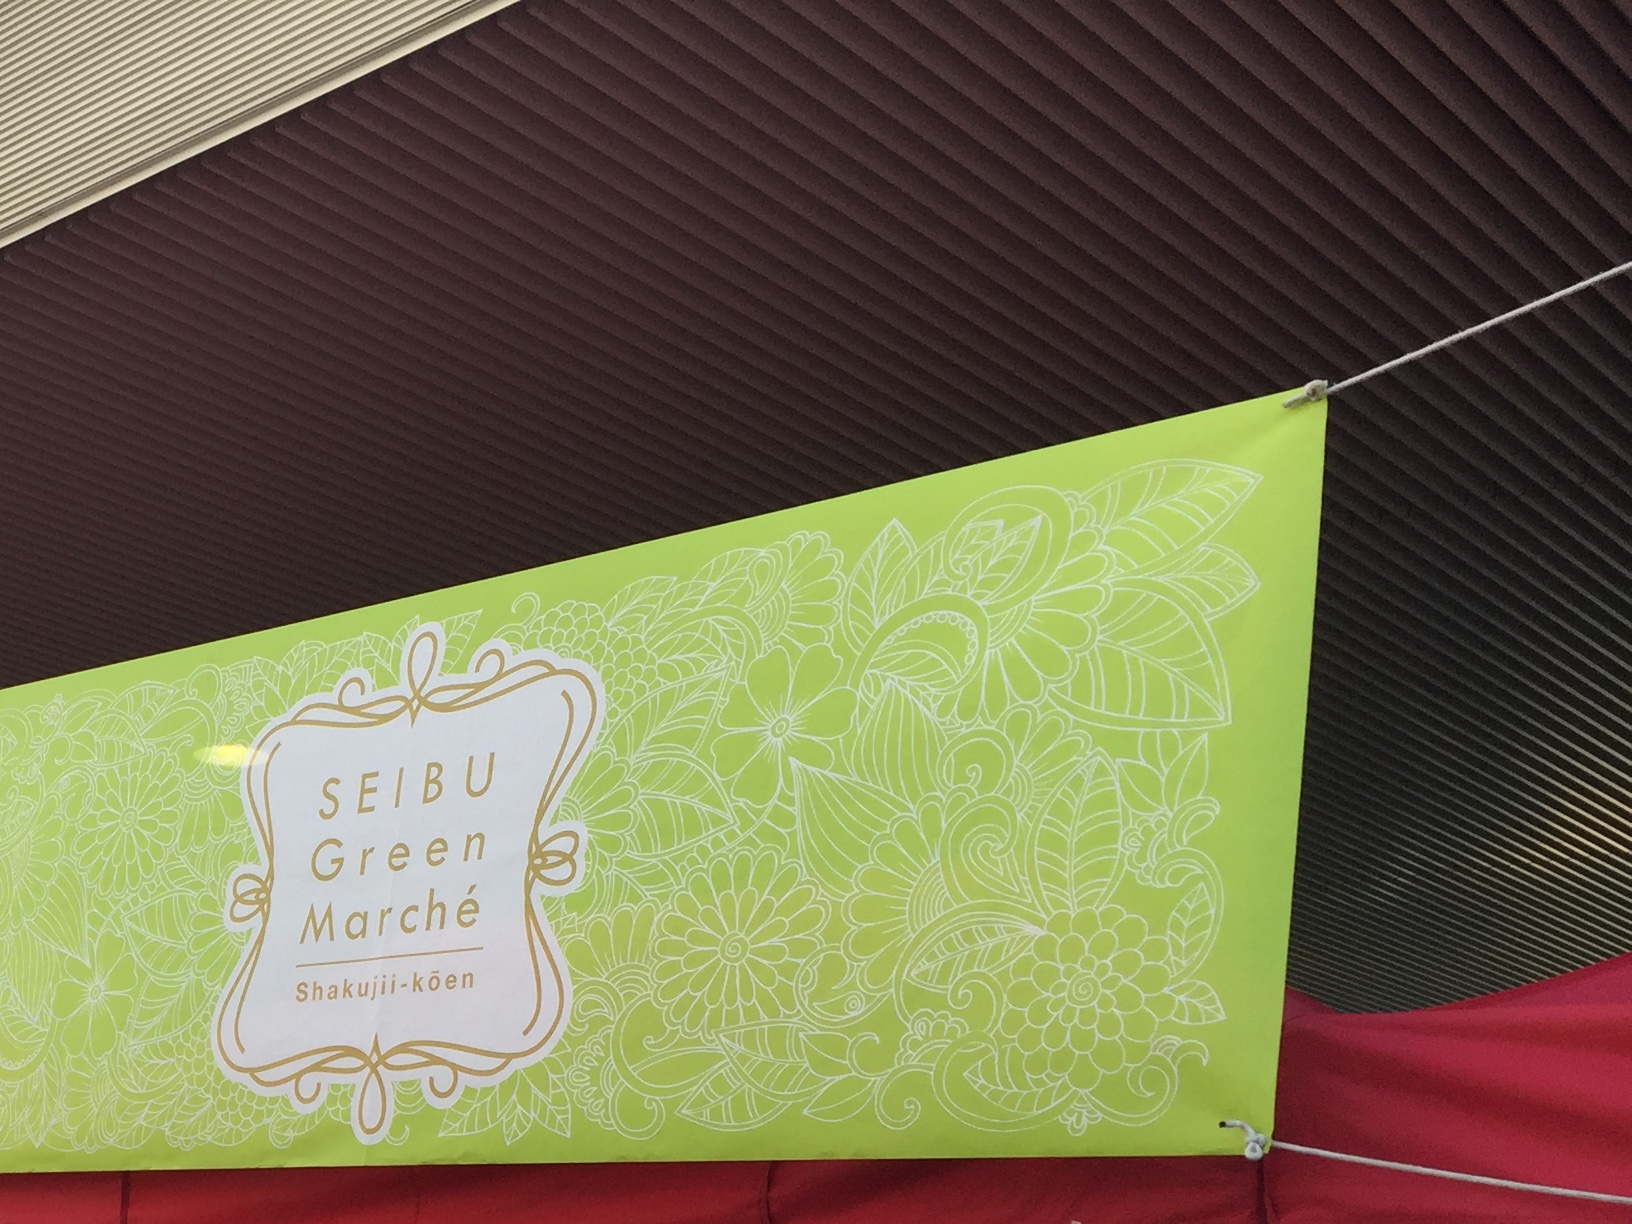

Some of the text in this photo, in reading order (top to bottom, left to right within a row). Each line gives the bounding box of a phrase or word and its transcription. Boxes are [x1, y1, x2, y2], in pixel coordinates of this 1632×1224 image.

[318, 751, 497, 820] SEIBU
[310, 831, 487, 881] Green
[299, 885, 480, 945] Marché
[295, 969, 475, 1002] Shakujii-kōen
